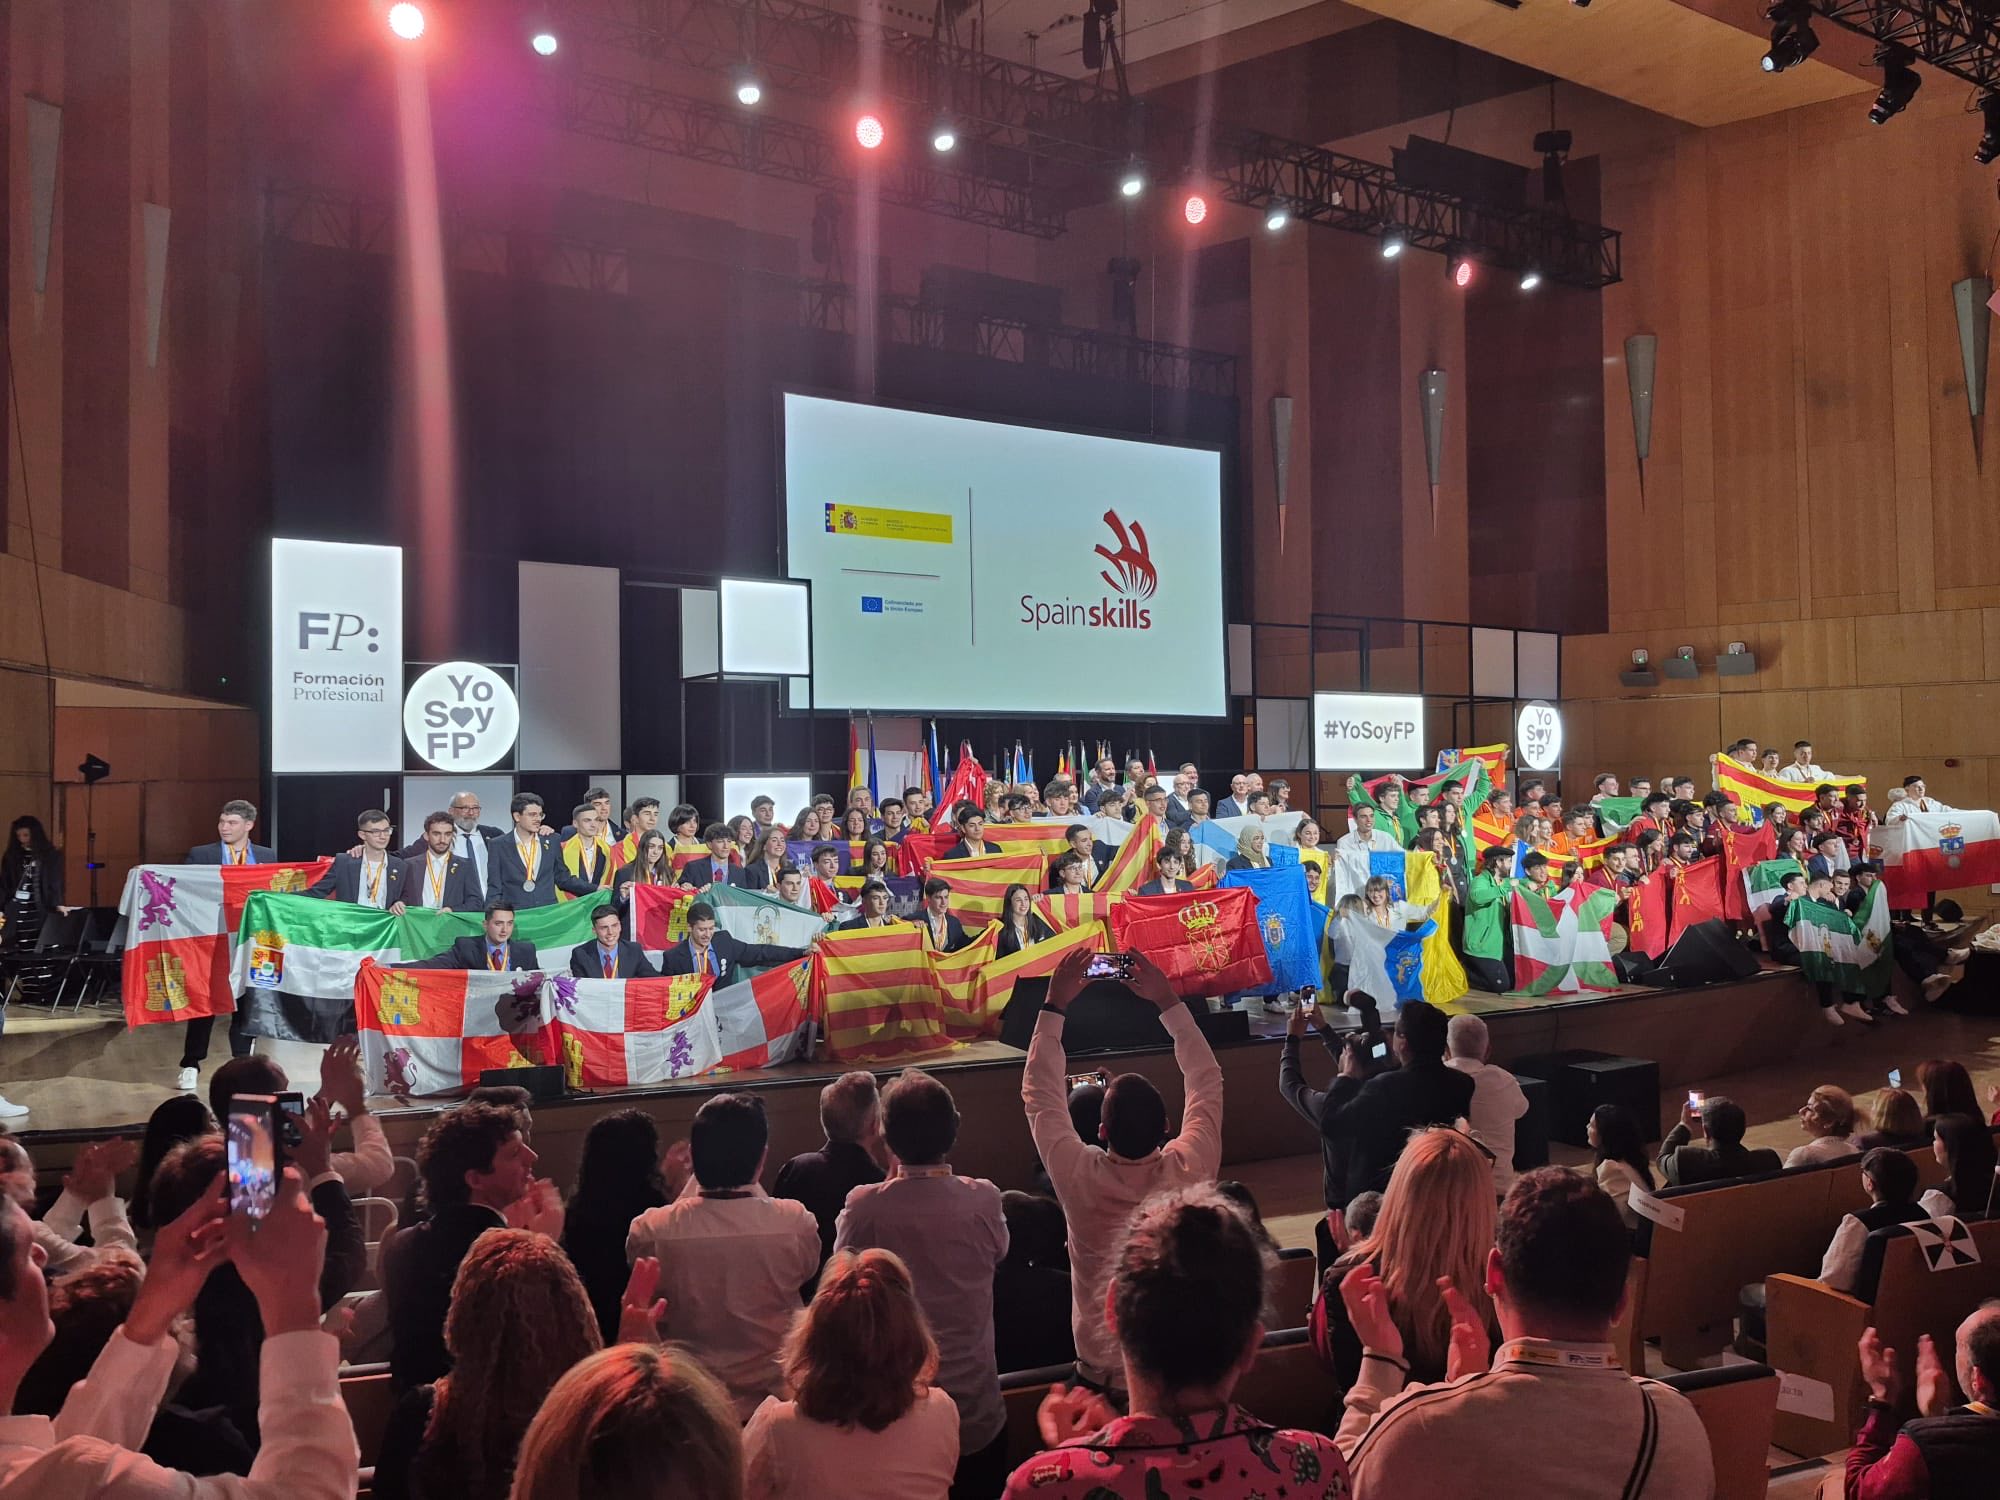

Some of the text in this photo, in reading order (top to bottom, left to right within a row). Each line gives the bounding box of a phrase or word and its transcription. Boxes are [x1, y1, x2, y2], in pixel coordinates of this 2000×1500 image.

[293, 671, 385, 687] Formación
[293, 686, 384, 702] Profesional
[448, 675, 494, 702] Yo
[1535, 708, 1552, 726] Yo
[1324, 720, 1415, 743] #YoSoyFP
[427, 732, 476, 760] FP
[1527, 744, 1545, 761] FP
